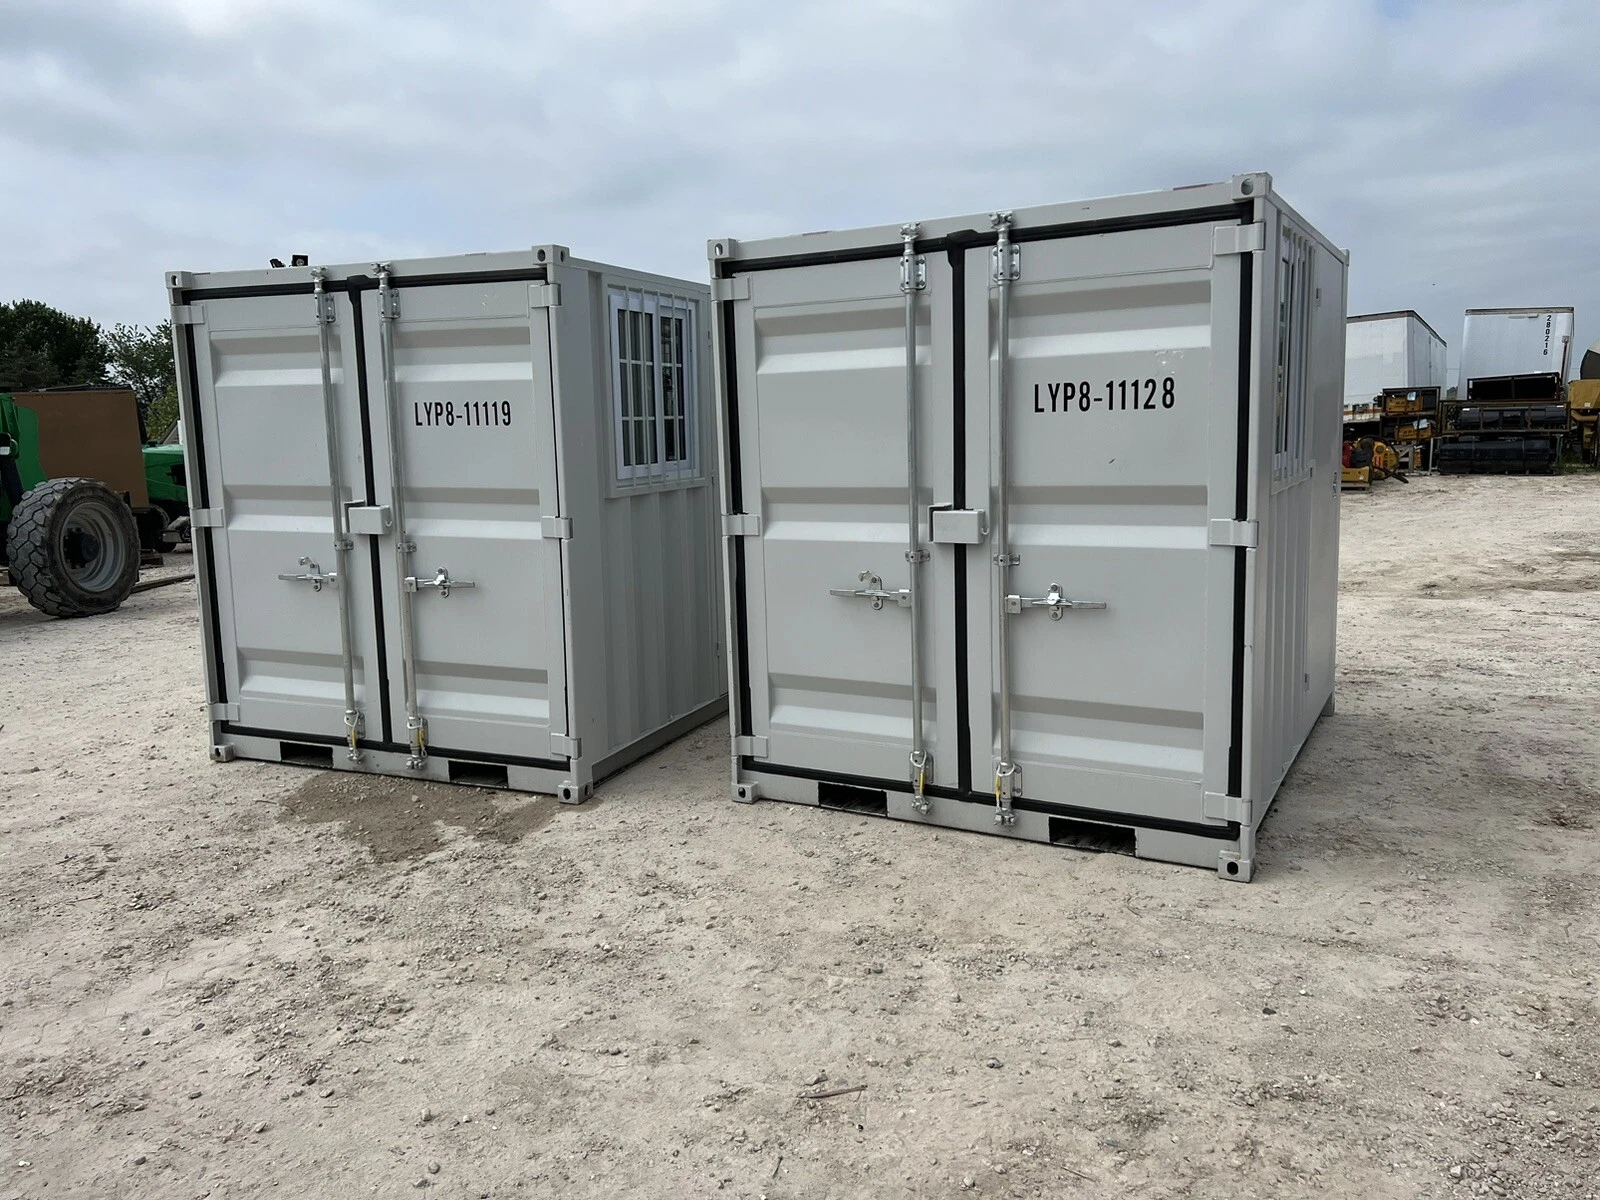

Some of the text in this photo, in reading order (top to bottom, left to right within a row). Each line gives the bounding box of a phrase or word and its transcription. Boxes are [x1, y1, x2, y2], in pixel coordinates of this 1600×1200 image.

[1542, 314, 1552, 356] 280216
[414, 400, 512, 427] LYP8-11119
[1034, 377, 1176, 414] LYP8-11128
